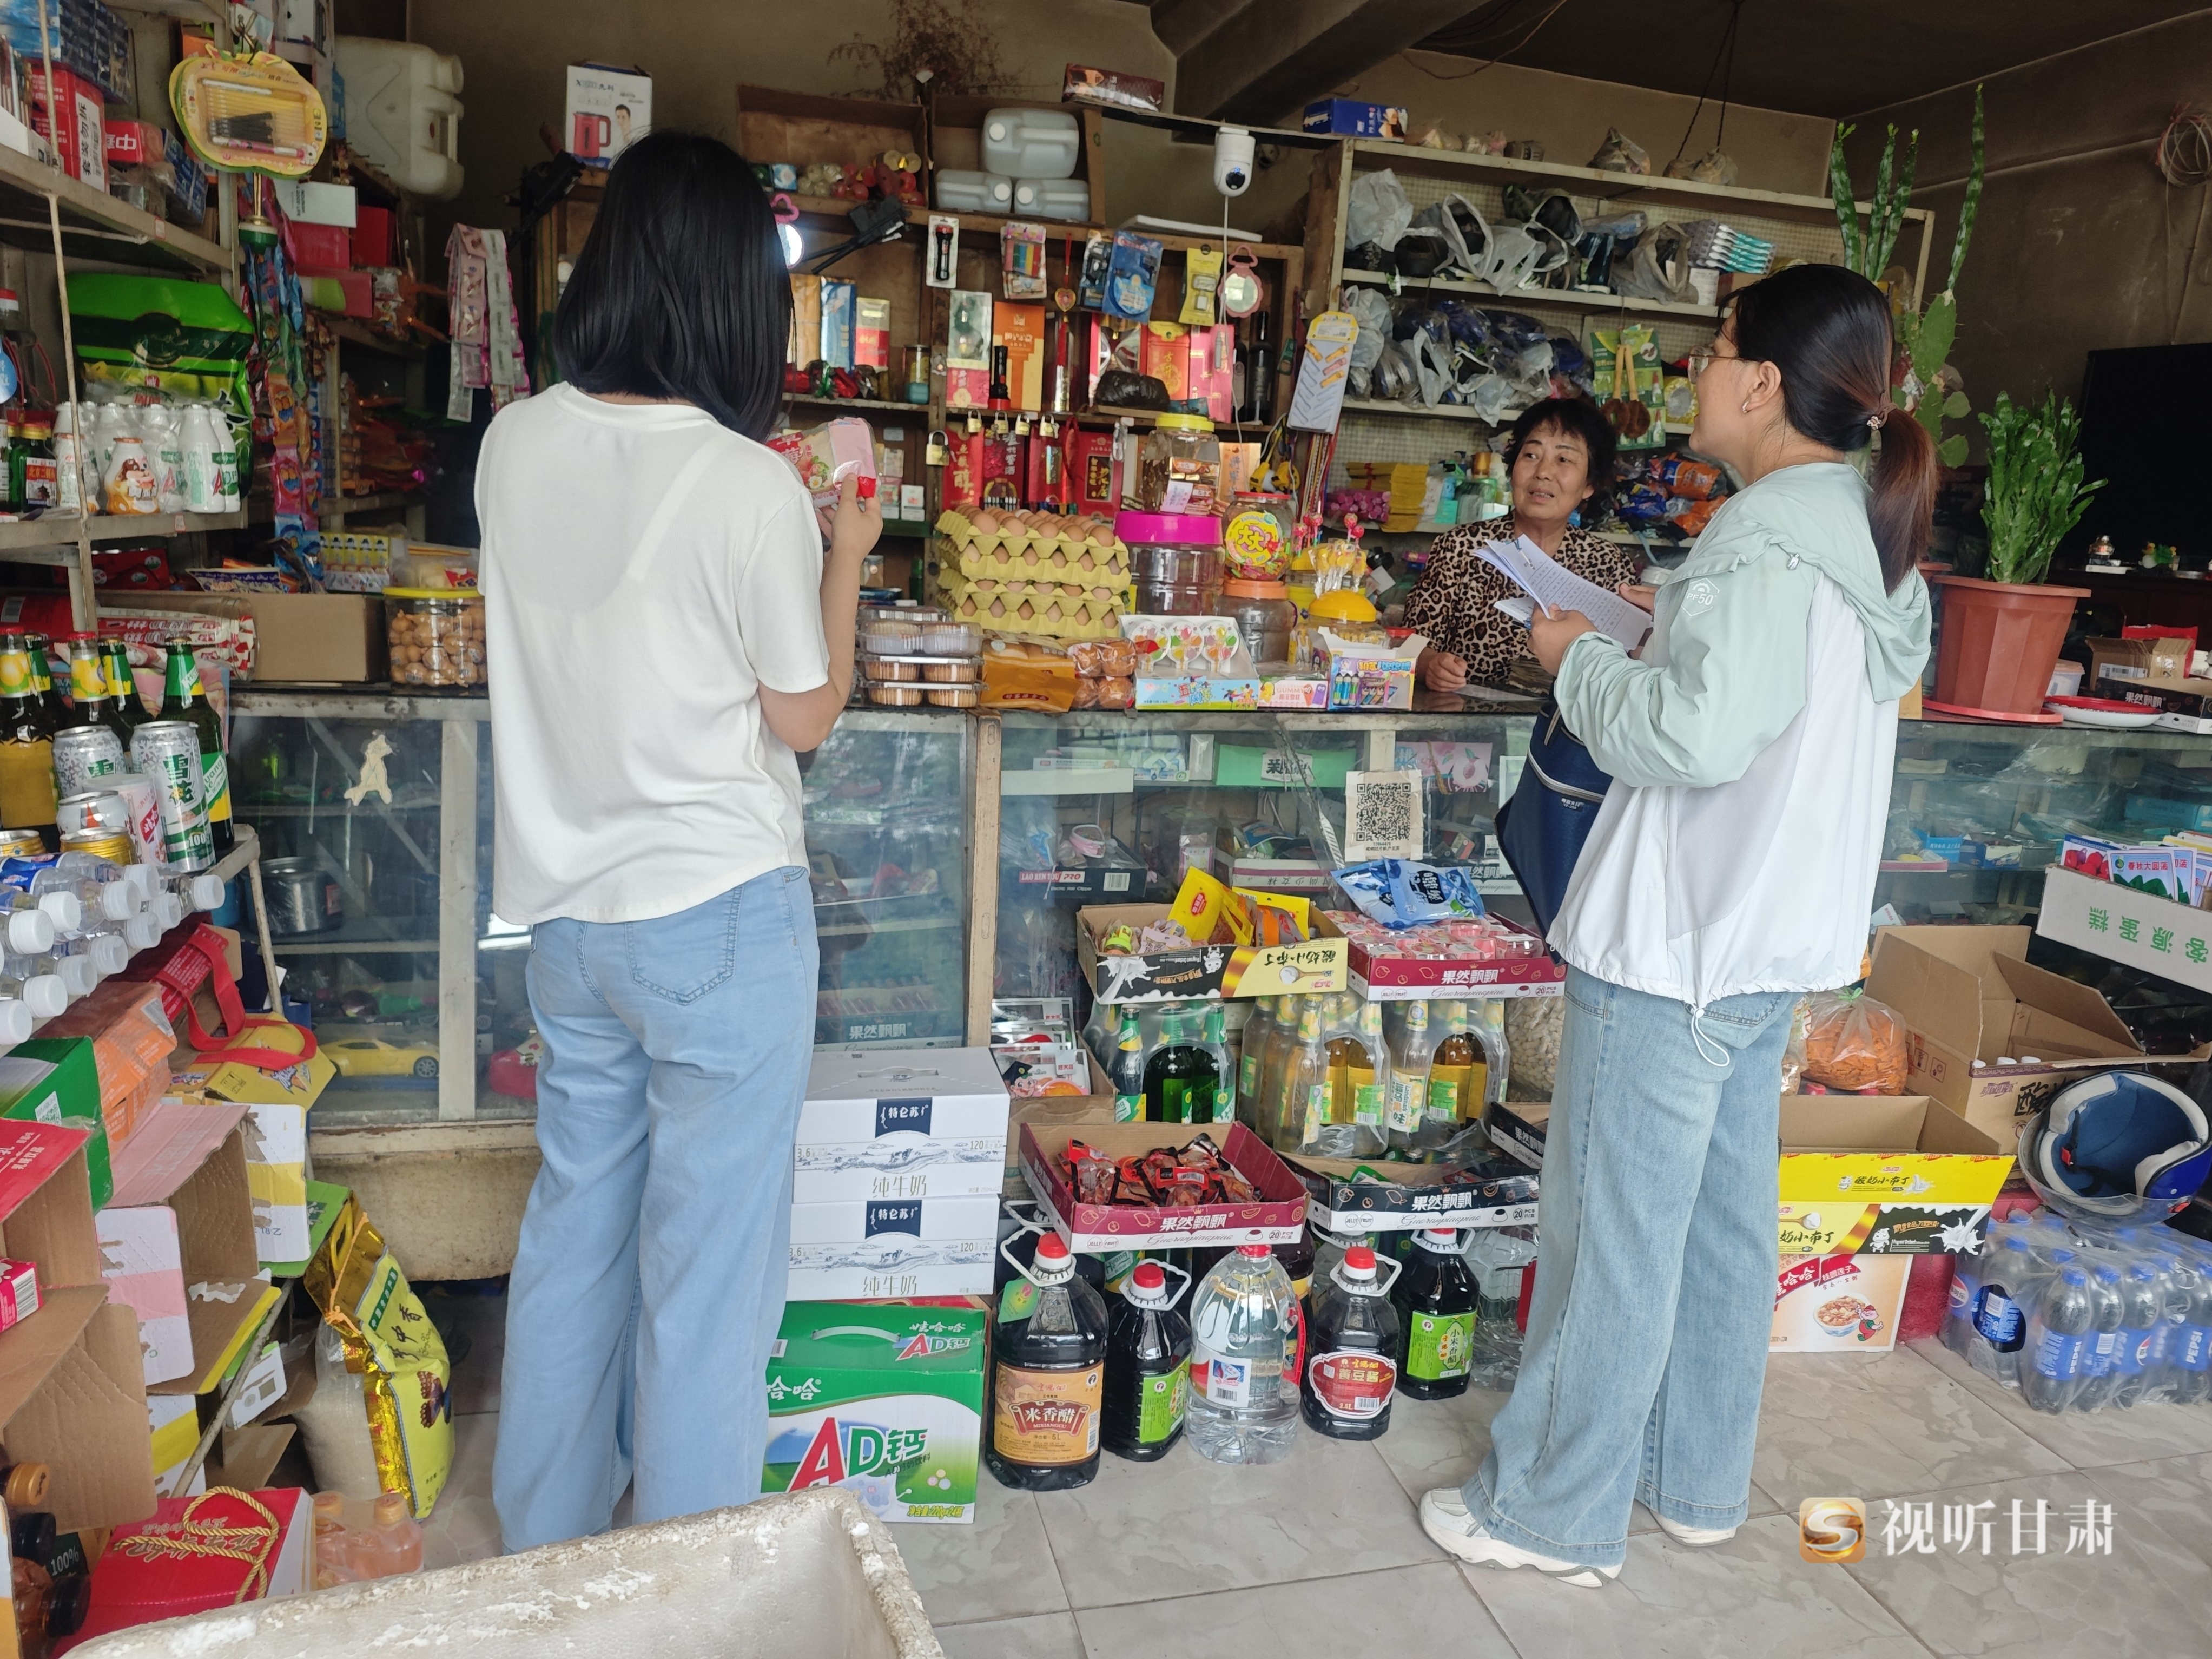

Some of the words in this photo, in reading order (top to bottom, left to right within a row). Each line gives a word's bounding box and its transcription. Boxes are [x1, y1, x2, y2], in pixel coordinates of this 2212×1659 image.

[78, 101, 91, 176] 套装勿拆
[1237, 524, 1265, 552] 大大
[2125, 692, 2163, 708] 果然飘飘
[1021, 873, 1037, 881] LAO
[2088, 906, 2209, 963] 客源蛋糕
[1264, 949, 1336, 967] 酸奶小布丁
[1441, 969, 1499, 985] 果然飘飘
[849, 1024, 908, 1040] 果然飘飘
[888, 1105, 920, 1120] 特仑苏
[797, 1147, 811, 1158] 3.6
[970, 1140, 984, 1151] 120
[872, 1175, 928, 1197] 纯牛奶
[1854, 1175, 1910, 1186] 酸奶小布丁
[1411, 1191, 1473, 1212] 果然飘飘
[877, 1208, 908, 1221] 特仑苏
[1159, 1214, 1227, 1232] 果然飘飘
[1345, 1216, 1359, 1225] JELLY
[1359, 1216, 1374, 1225] FRUIT
[1514, 1209, 1523, 1219] 20
[1270, 1232, 1280, 1240] 20
[960, 1242, 974, 1252] 120
[863, 1275, 918, 1297] 纯牛奶
[908, 1321, 966, 1333] 娃哈哈
[895, 1333, 971, 1361] AD钙
[1447, 1329, 1460, 1364] 小米香醋
[2185, 1330, 2204, 1364] PEPSI
[2068, 1340, 2082, 1374] PEPSI
[1338, 1368, 1379, 1383] 黄豆酱
[1024, 1407, 1076, 1424] 米香醋
[787, 1416, 929, 1493] AD钙
[50, 1546, 80, 1577] 100%
